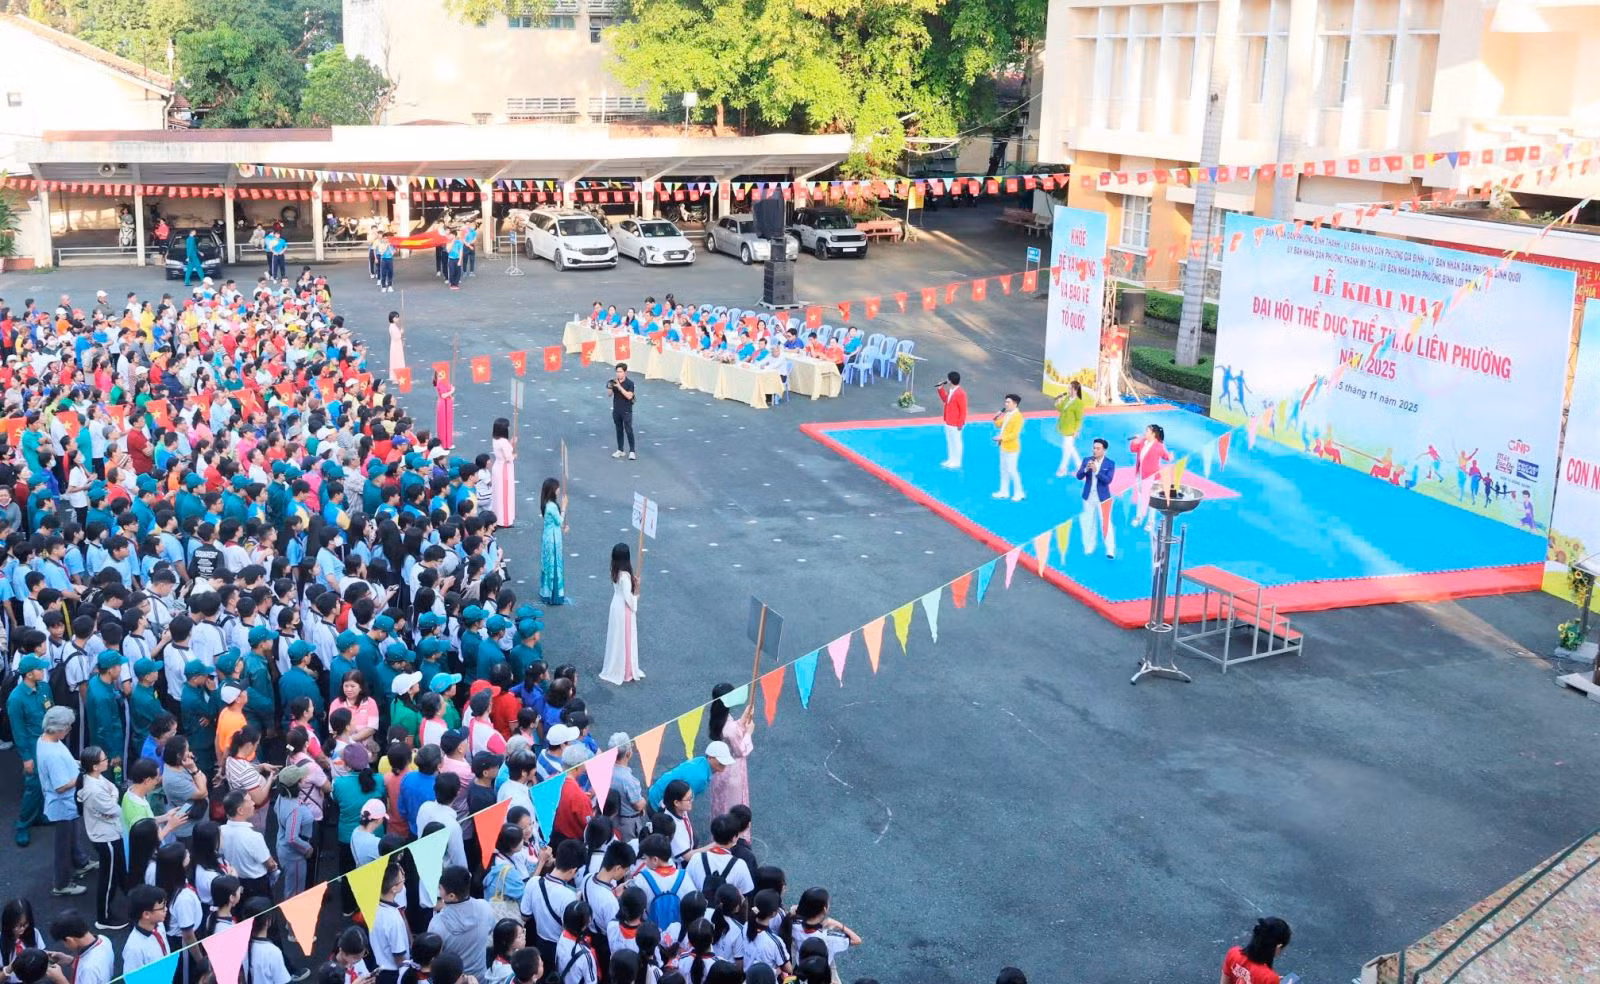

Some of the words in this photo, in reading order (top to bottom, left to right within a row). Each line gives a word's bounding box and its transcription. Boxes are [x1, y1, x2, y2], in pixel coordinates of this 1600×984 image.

[1312, 268, 1336, 296] LỄ
[1341, 281, 1393, 309] KHAI
[1252, 296, 1271, 320] ĐẠI
[1274, 298, 1294, 326] HỘI
[1297, 301, 1323, 329] THỂ
[1323, 312, 1348, 338] DỤC
[1352, 314, 1379, 343] THỂ
[1417, 334, 1448, 363] LIÊN
[1452, 344, 1512, 379] PHƯỜNG
[1366, 358, 1397, 379] 2025
[1345, 383, 1368, 400] tháng
[1399, 399, 1419, 413] 2025
[1566, 457, 1590, 488] CON
